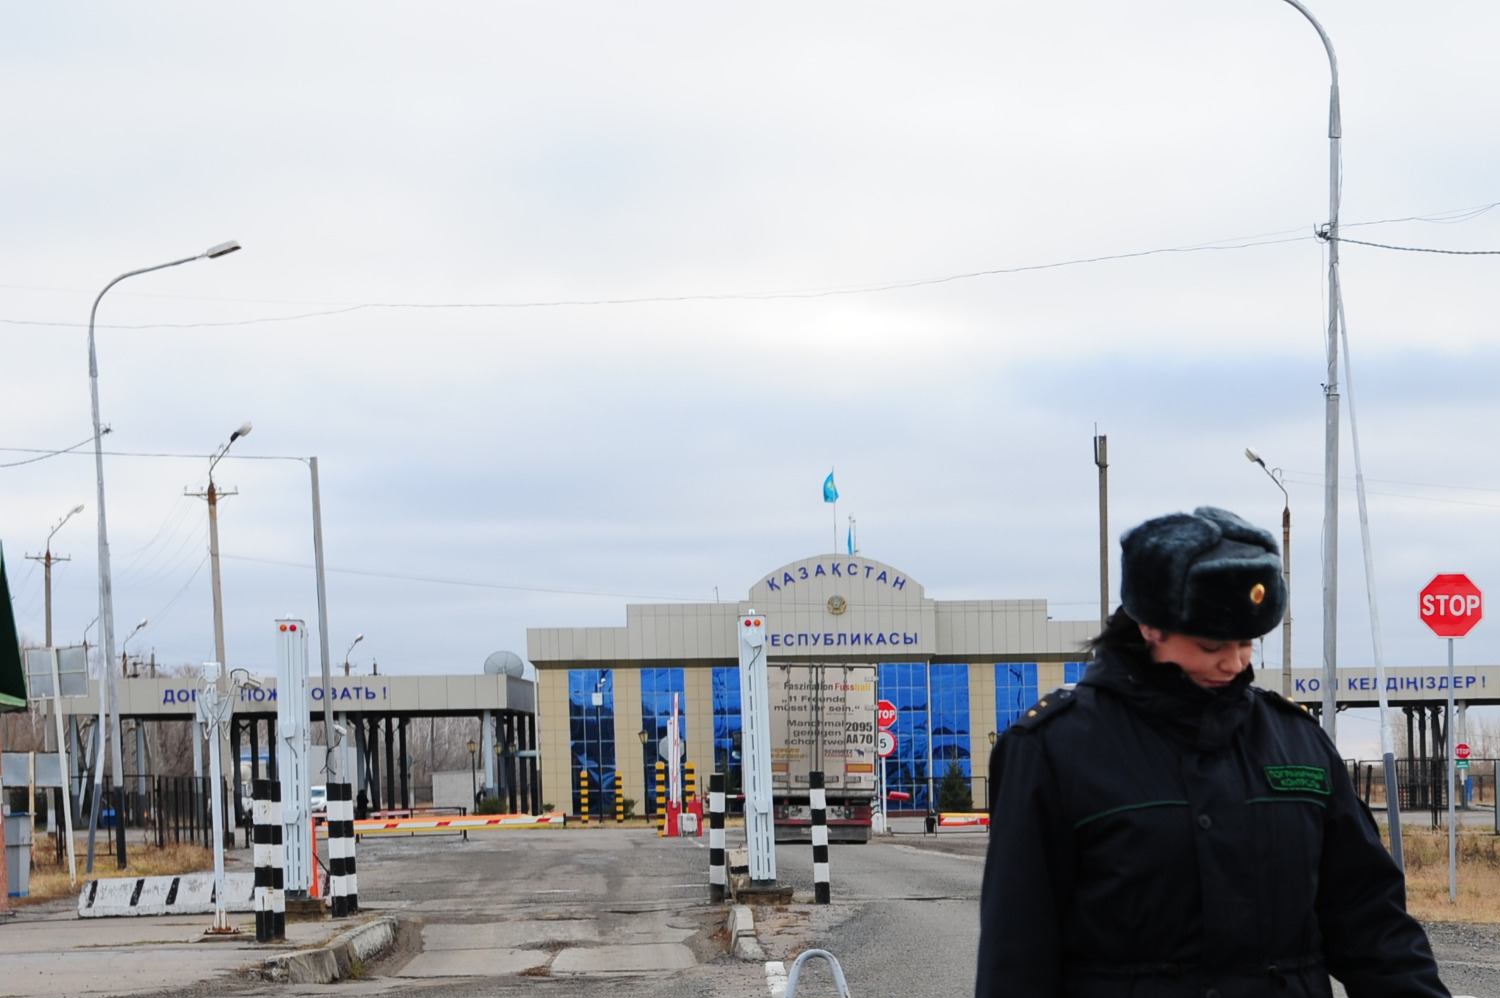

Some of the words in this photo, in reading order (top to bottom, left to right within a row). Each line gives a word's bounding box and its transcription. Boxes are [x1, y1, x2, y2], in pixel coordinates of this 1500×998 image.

[766, 562, 906, 592] ҚАЗАҚСТАН
[1421, 594, 1480, 617] STOP
[764, 632, 918, 647] ЕСПУБЛИКАСЫ
[784, 682, 833, 691] Faszinaion
[834, 682, 871, 691] Fussball
[1295, 678, 1338, 694] ҚО
[240, 686, 376, 703] ПОЖОВАТЬ
[878, 709, 896, 720] TOP
[786, 719, 844, 727] Manchmal
[845, 722, 873, 732] 2095
[880, 738, 887, 749] 5
